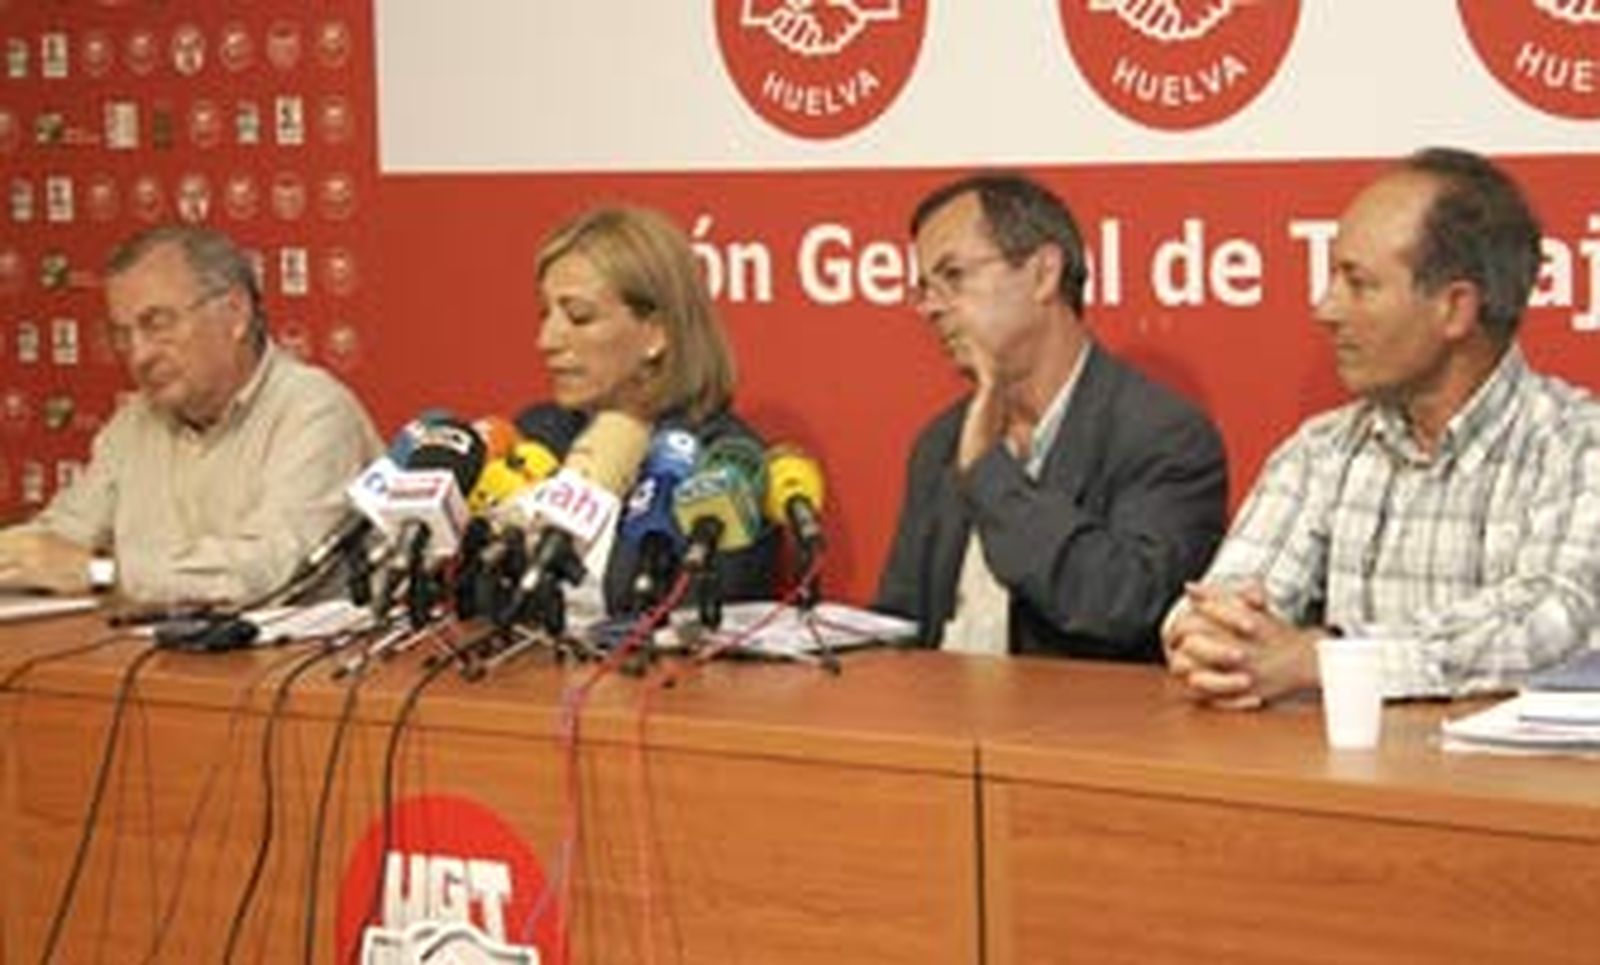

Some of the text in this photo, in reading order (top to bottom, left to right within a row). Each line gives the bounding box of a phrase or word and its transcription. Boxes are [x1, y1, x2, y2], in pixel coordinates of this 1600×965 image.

[763, 68, 880, 116] HUELVA
[1112, 54, 1249, 106] HUELVA
[1152, 218, 1263, 307] de
[382, 851, 513, 943] UGT
